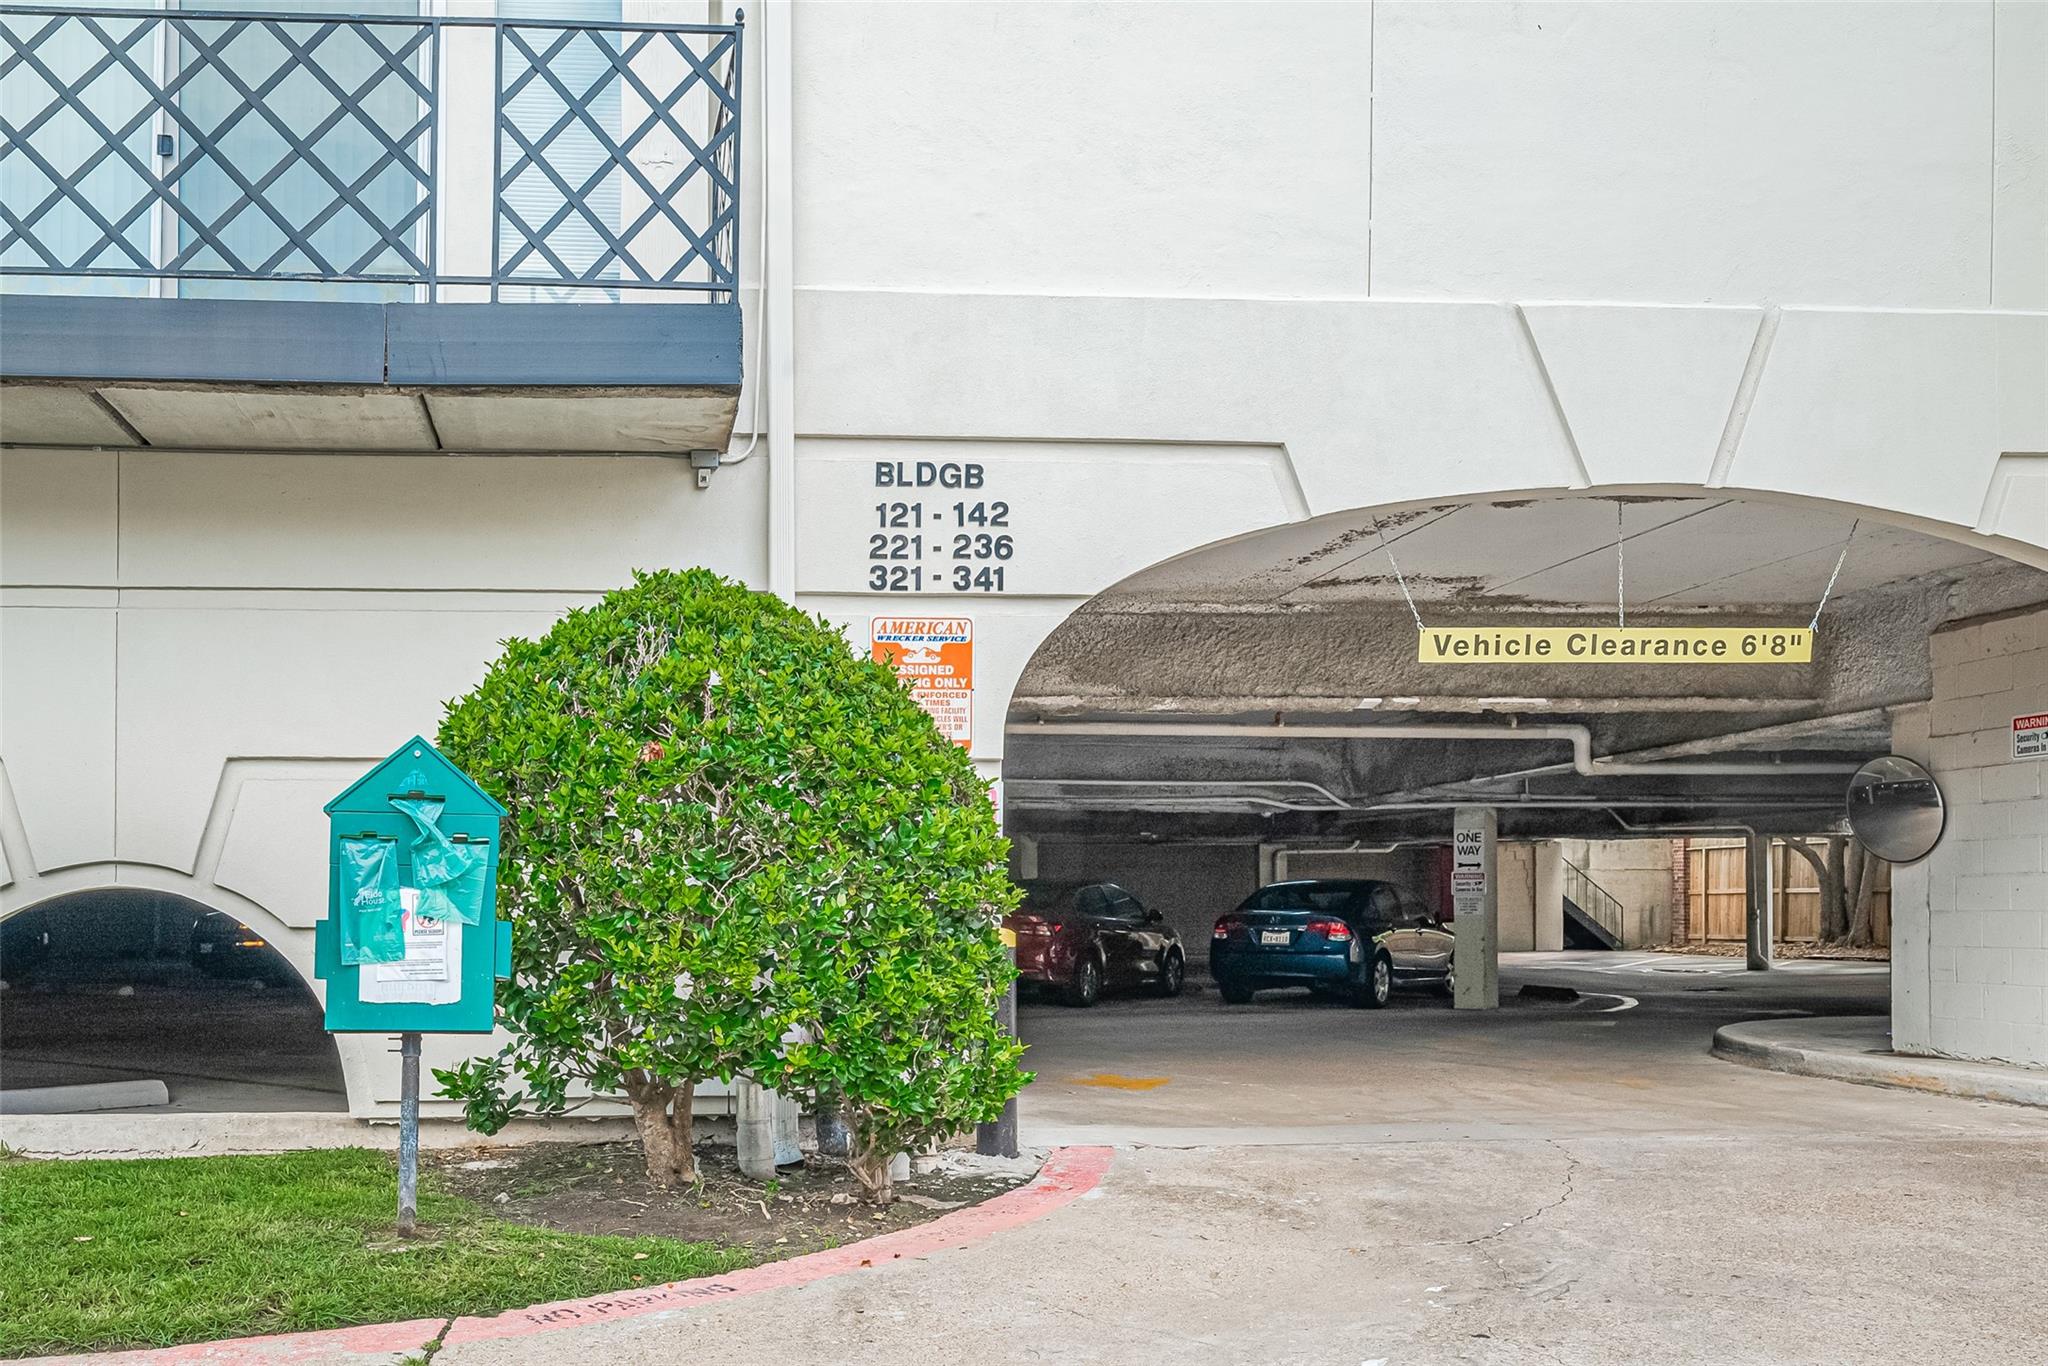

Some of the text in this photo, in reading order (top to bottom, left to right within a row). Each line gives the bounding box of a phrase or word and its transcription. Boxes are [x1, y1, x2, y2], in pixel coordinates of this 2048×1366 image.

[875, 461, 984, 489] BLDGB
[875, 502, 922, 528] 121
[953, 501, 1009, 527] 142
[869, 534, 922, 560] 221
[952, 534, 1014, 560] 236
[869, 565, 922, 591] 321
[953, 566, 1004, 592] 341
[876, 621, 968, 635] AMERICAN
[1433, 633, 1802, 657] Vehicle Clearance 6'8"
[897, 664, 954, 675] SSIGNED
[934, 677, 968, 688] ONLY
[1456, 832, 1482, 843] ONE
[1457, 845, 1481, 856] WAY
